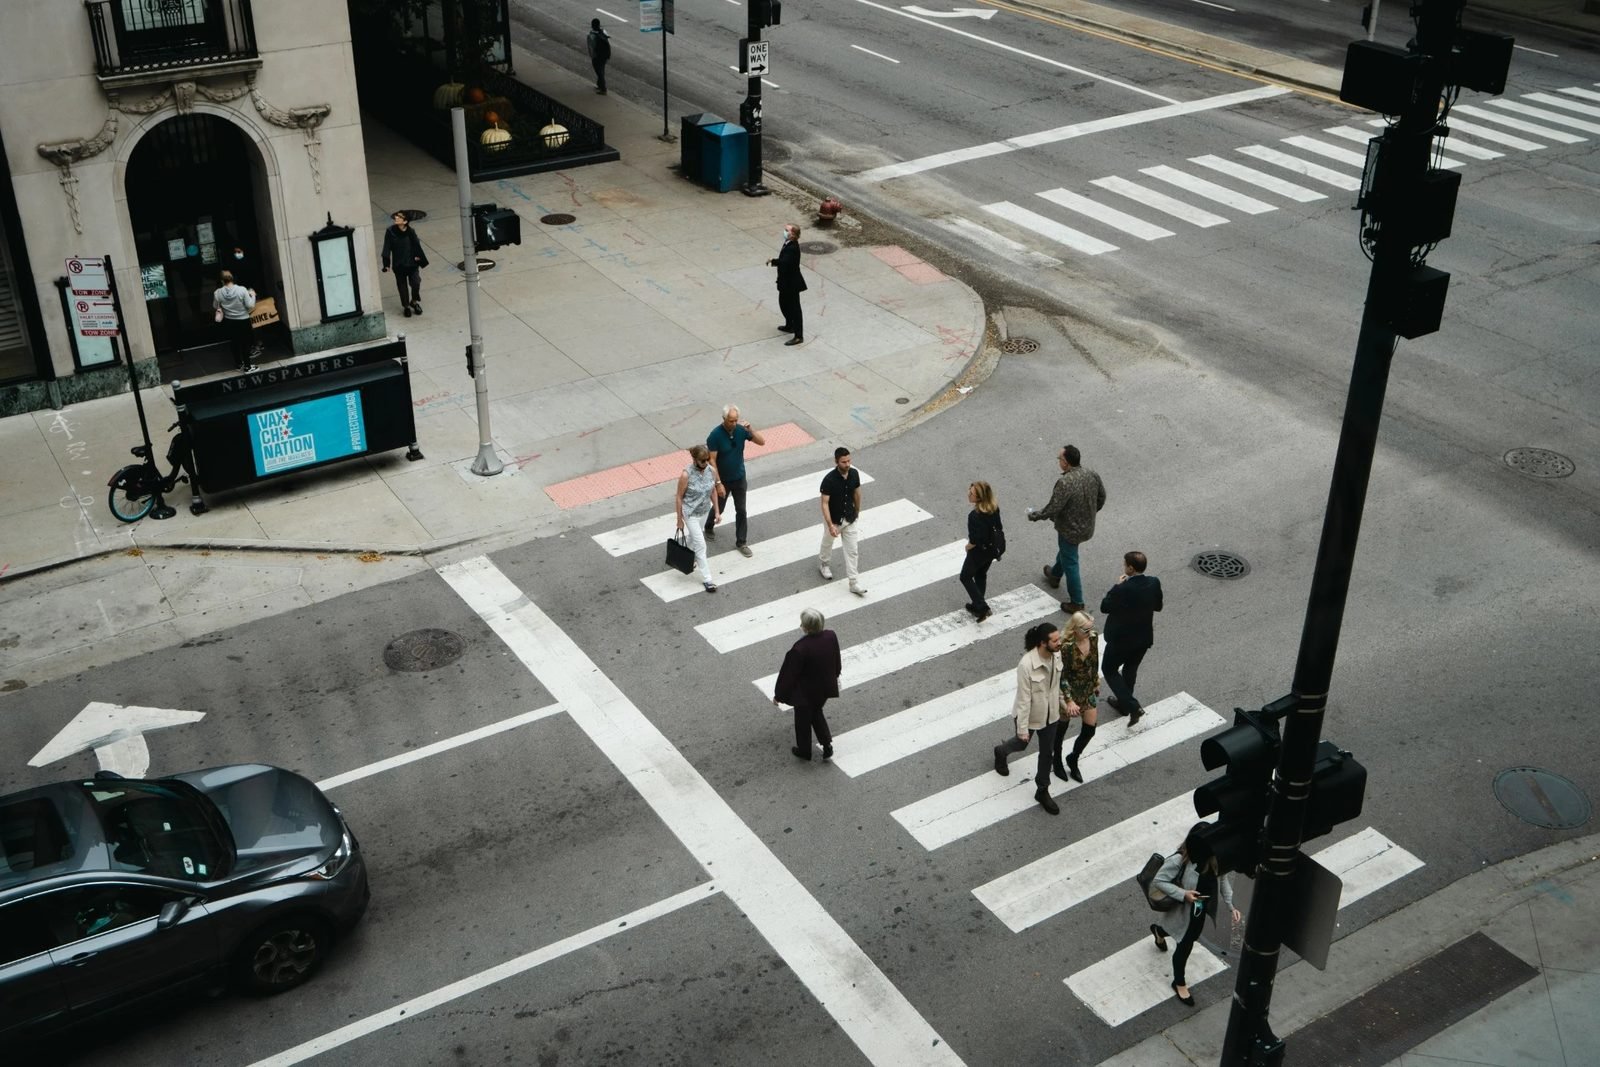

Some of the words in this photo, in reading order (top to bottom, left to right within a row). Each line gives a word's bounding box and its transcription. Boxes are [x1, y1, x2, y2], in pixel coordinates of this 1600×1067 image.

[750, 53, 767, 63] WAY
[751, 44, 767, 53] ONE
[250, 312, 268, 324] NIKE
[222, 355, 355, 393] NEWSPAPERS
[258, 410, 285, 430] VAX
[345, 392, 361, 451] #PROTECTCHICAGO
[263, 435, 313, 460] NATION
